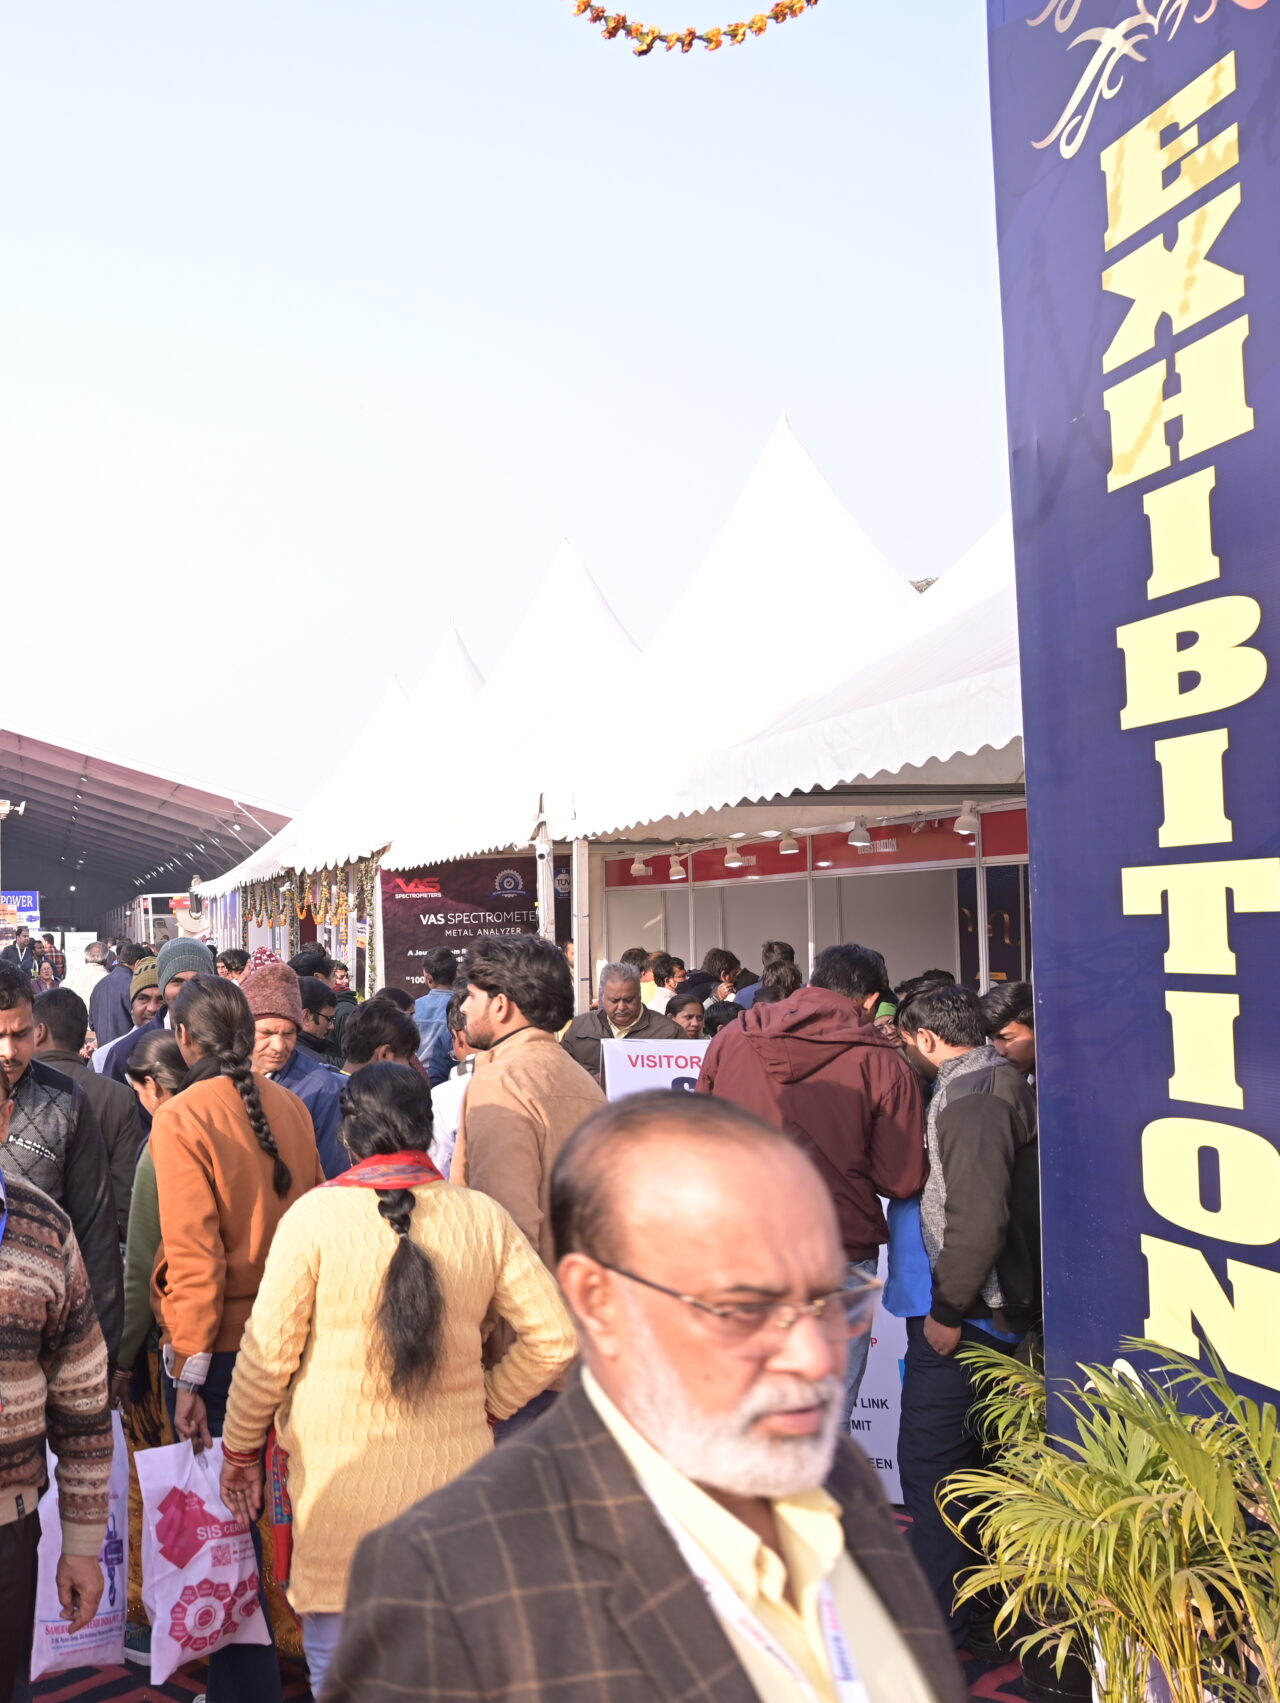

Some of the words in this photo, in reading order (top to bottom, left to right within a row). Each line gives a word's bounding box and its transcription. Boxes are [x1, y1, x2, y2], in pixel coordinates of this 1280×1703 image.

[395, 878, 441, 892] VAS
[0, 895, 33, 907] POWER
[420, 913, 445, 925] VAS
[445, 929, 474, 937] METAL
[477, 927, 521, 936] ANALYZER
[860, 1398, 889, 1410] LINK
[197, 1523, 223, 1541] SIS
